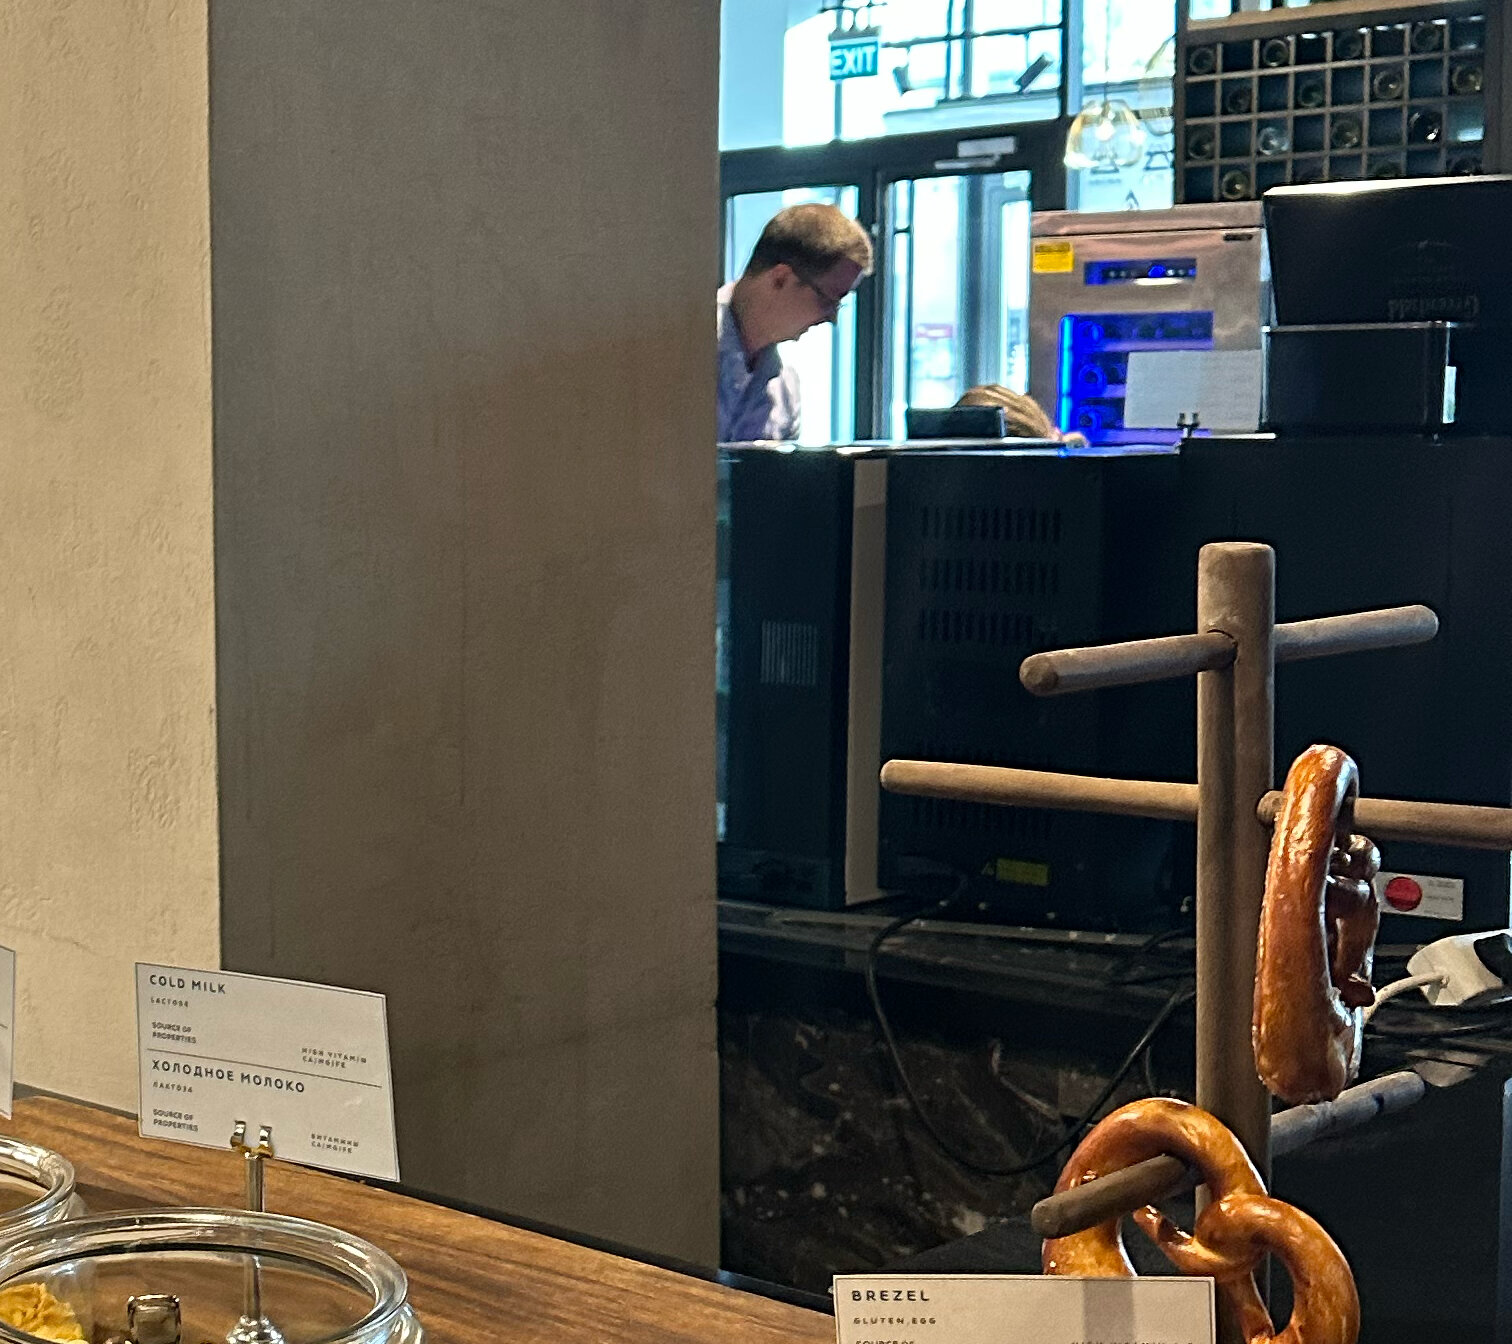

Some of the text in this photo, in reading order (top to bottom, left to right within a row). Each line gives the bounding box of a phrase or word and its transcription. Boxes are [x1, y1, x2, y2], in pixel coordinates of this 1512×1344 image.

[831, 44, 877, 76] EXIT
[149, 974, 225, 994] COLD MILK
[151, 1021, 180, 1031] SOURCE
[152, 1059, 305, 1093] ХОЛОДНОЕ МОЛОКО
[152, 1108, 182, 1120] SOURCE
[851, 1290, 930, 1302] BREZEL
